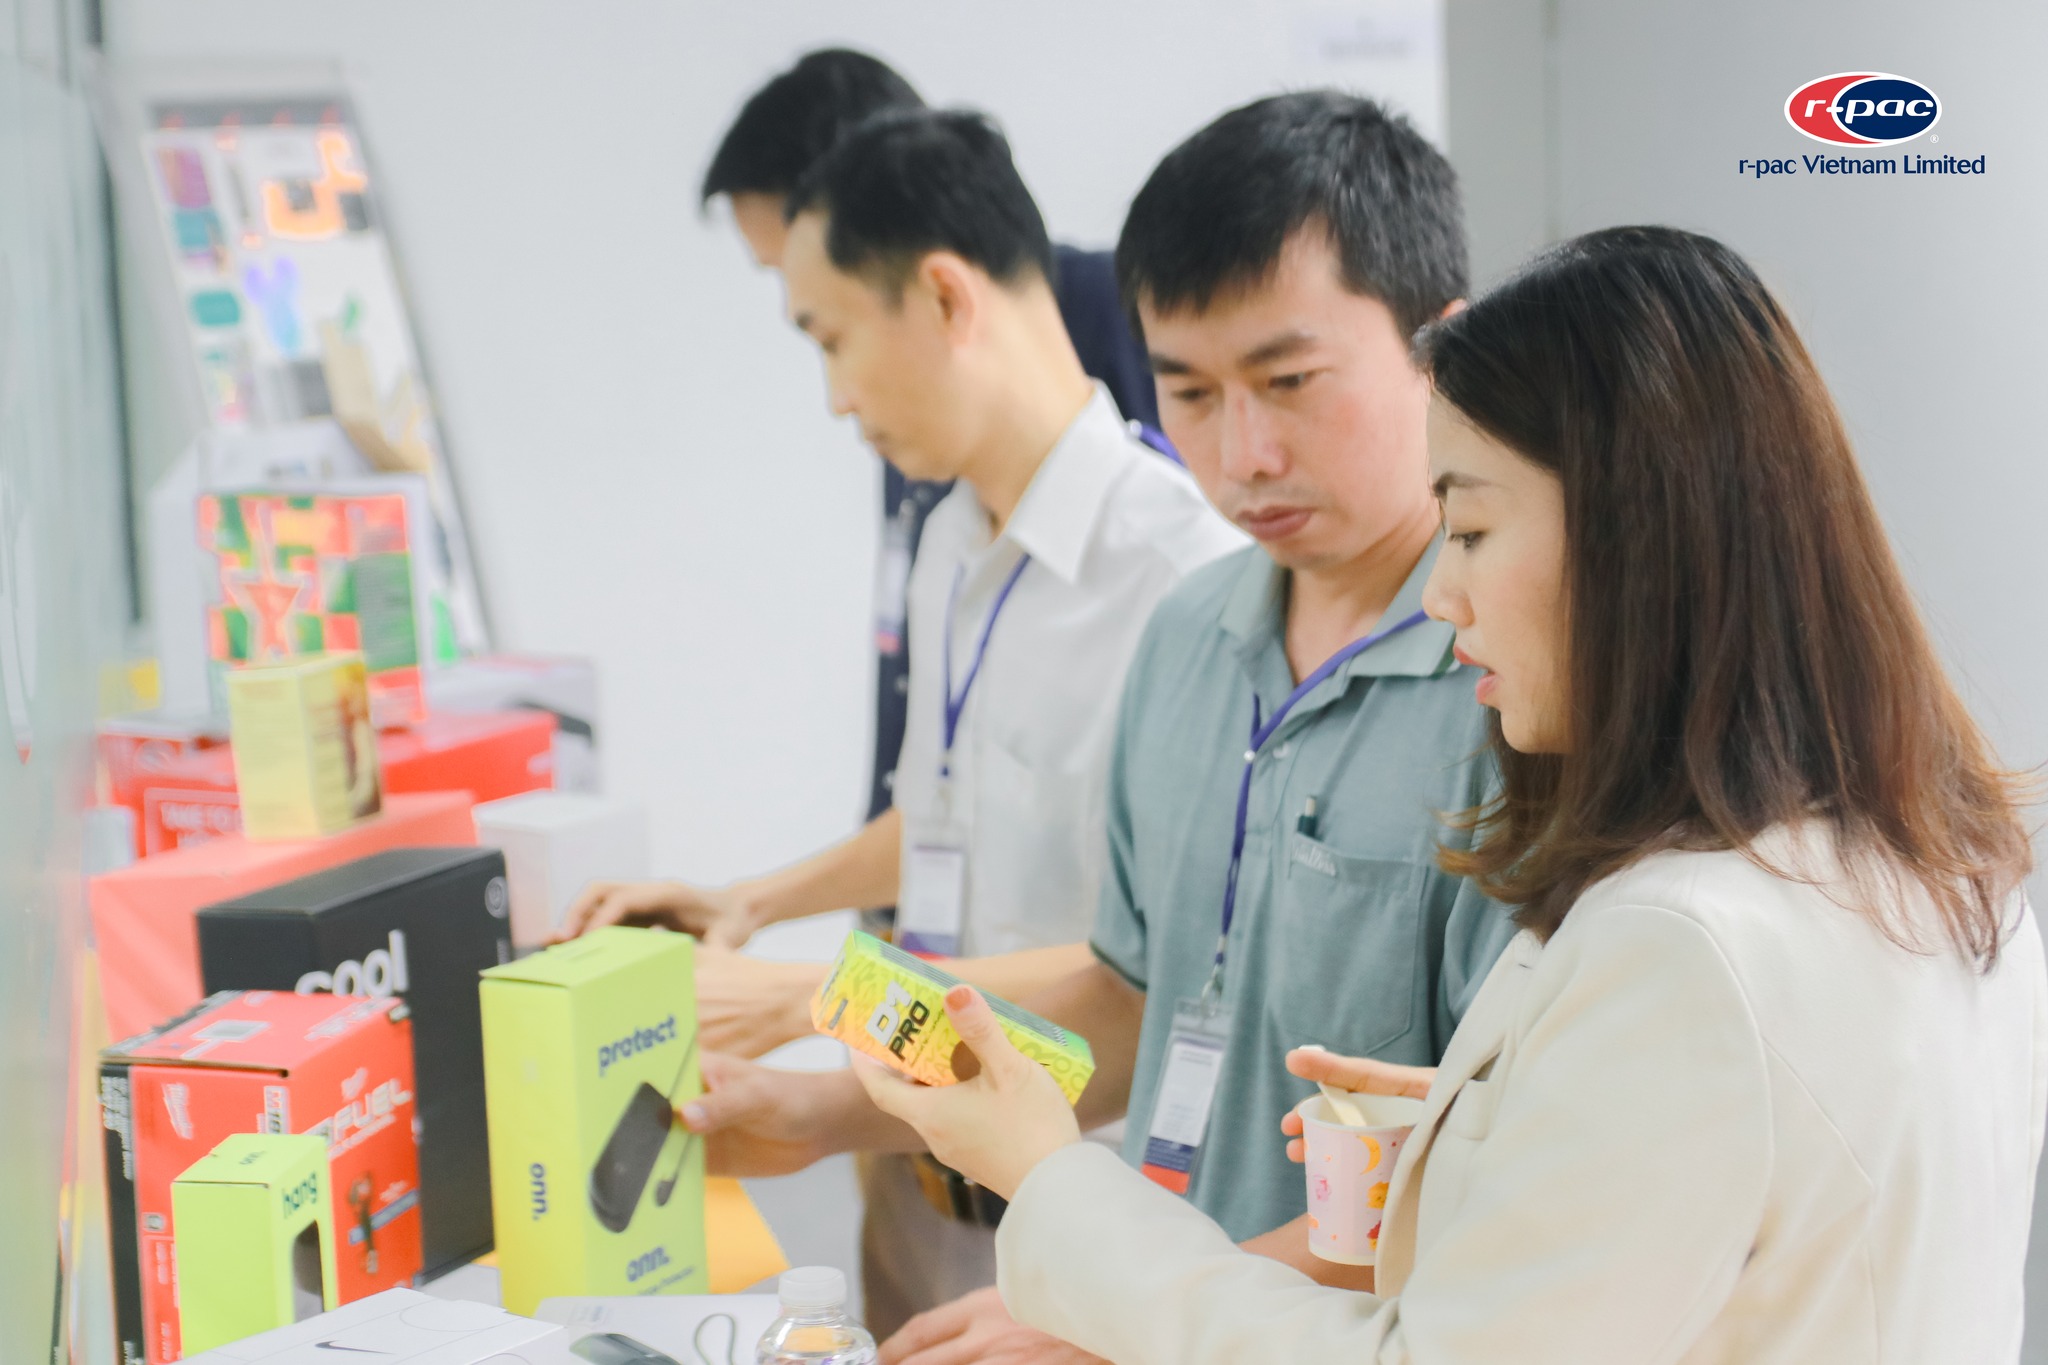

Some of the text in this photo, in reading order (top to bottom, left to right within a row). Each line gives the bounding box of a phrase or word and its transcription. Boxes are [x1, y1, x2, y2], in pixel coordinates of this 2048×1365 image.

[598, 1013, 676, 1078] protect
[888, 1000, 930, 1062] PRO
[333, 1078, 413, 1143] FUEL
[281, 1171, 318, 1220] hang
[529, 1162, 549, 1222] onn.
